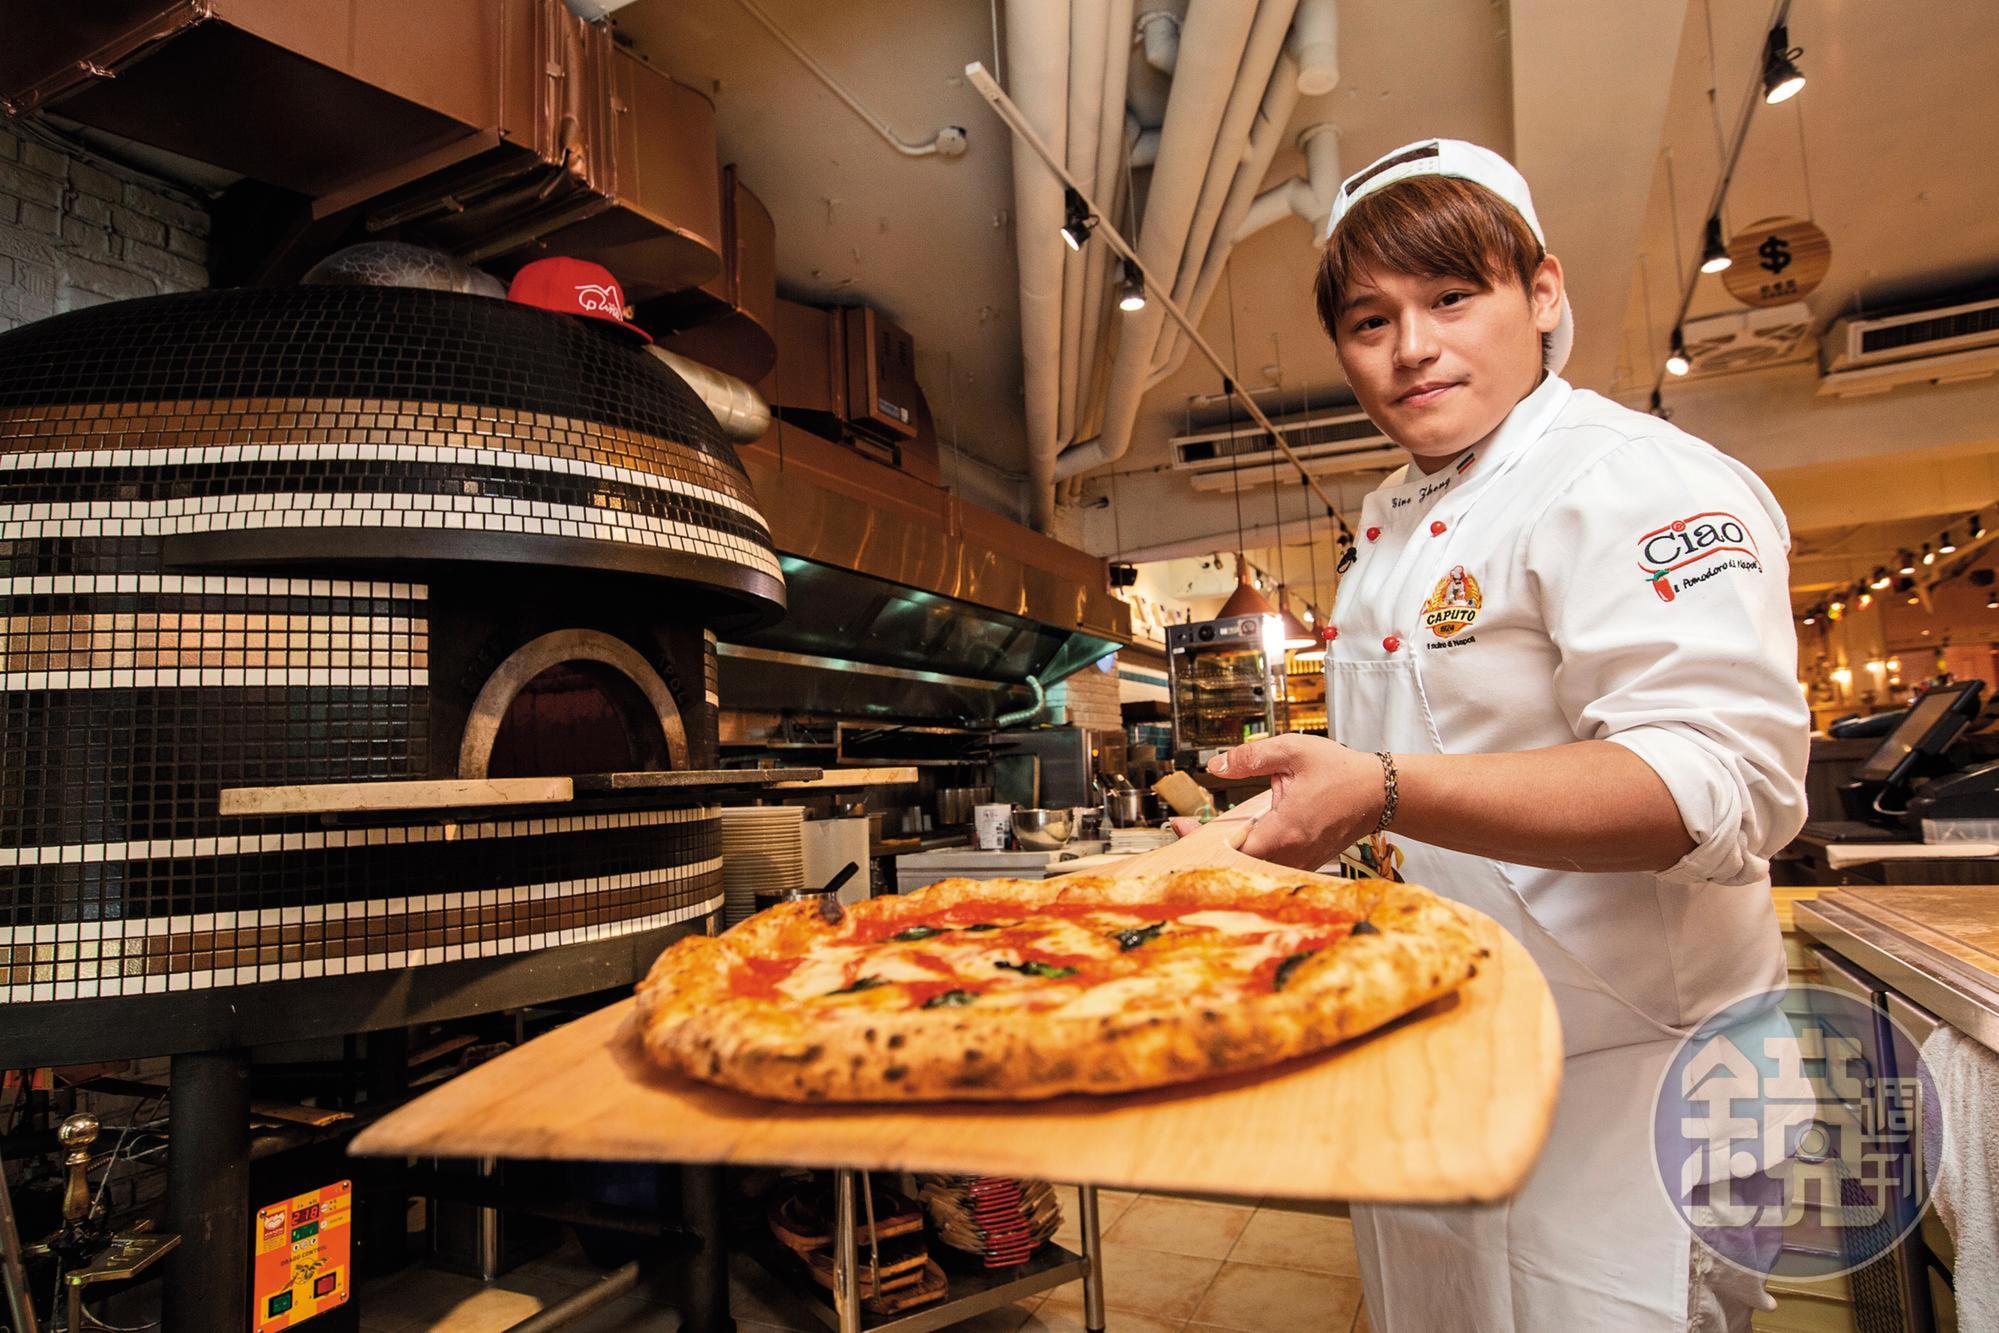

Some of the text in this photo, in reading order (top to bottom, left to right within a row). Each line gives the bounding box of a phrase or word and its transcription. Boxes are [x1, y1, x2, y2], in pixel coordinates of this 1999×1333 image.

[1644, 521, 1744, 565] Ciao
[1682, 562, 1728, 589] Pomodoro
[1426, 609, 1476, 625] CAPUTO
[292, 1205, 319, 1227] 218
